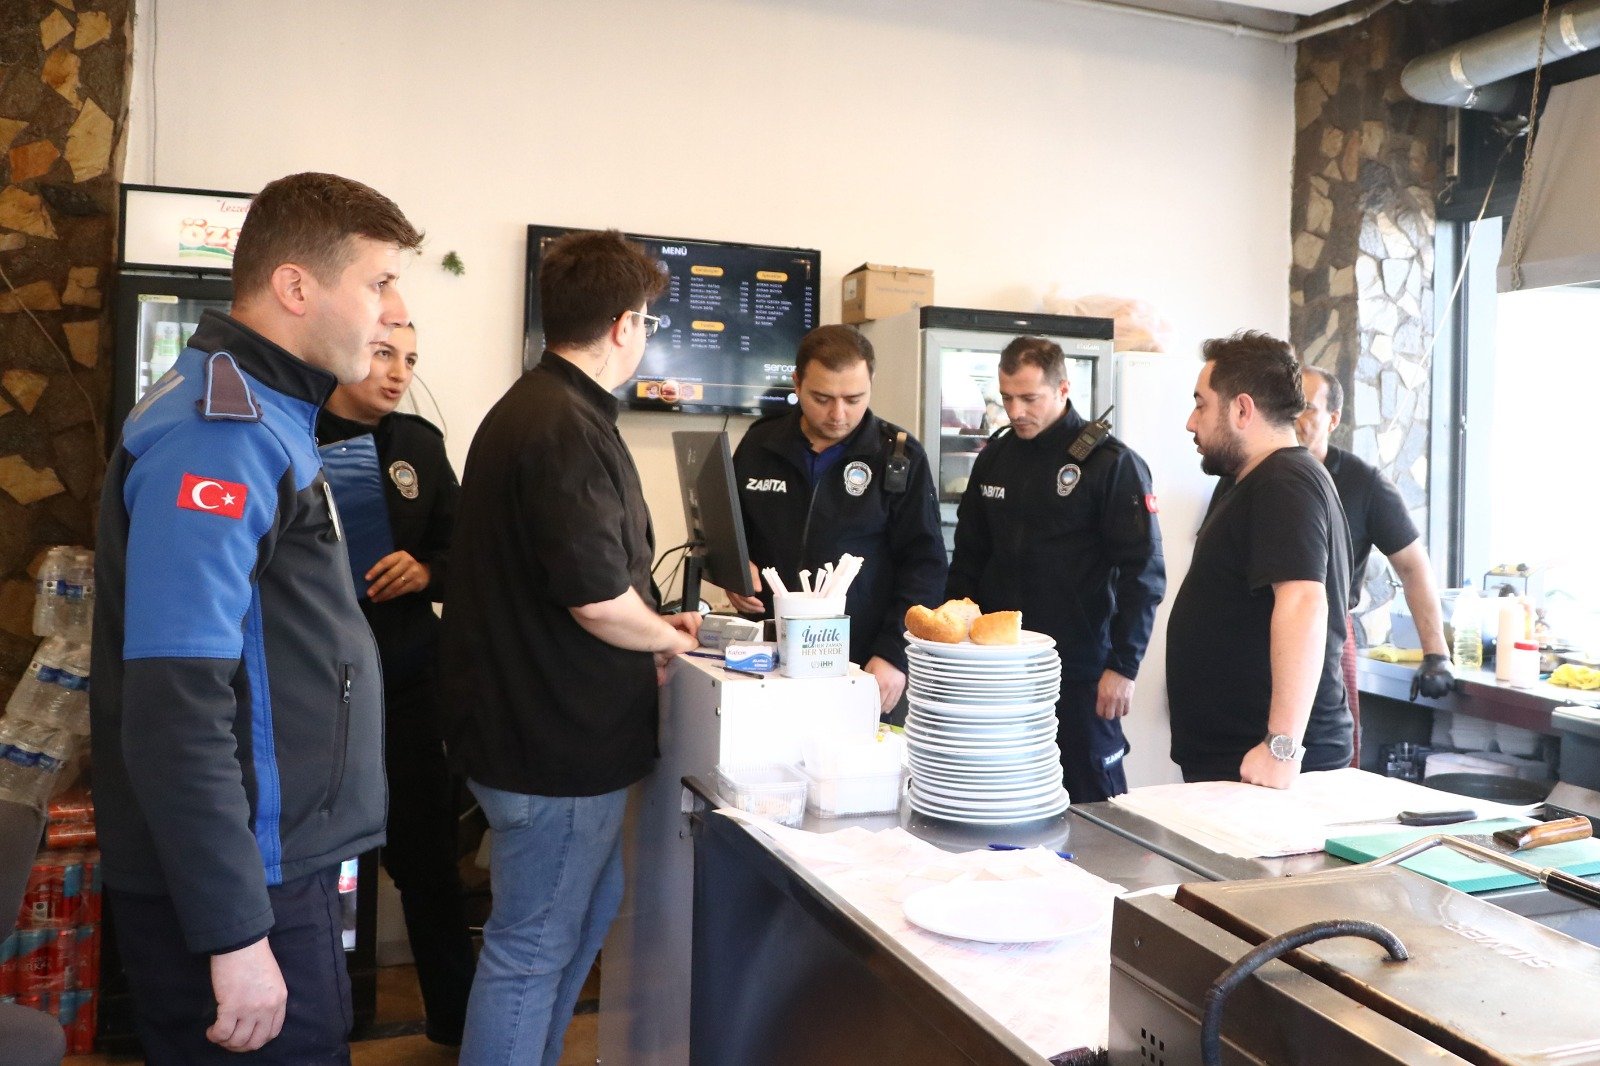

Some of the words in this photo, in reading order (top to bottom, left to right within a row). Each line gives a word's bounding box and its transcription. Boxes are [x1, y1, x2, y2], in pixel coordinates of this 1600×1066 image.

[662, 246, 688, 256] MENÜ
[746, 478, 787, 493] ZABITA
[802, 625, 840, 648] İyilik
